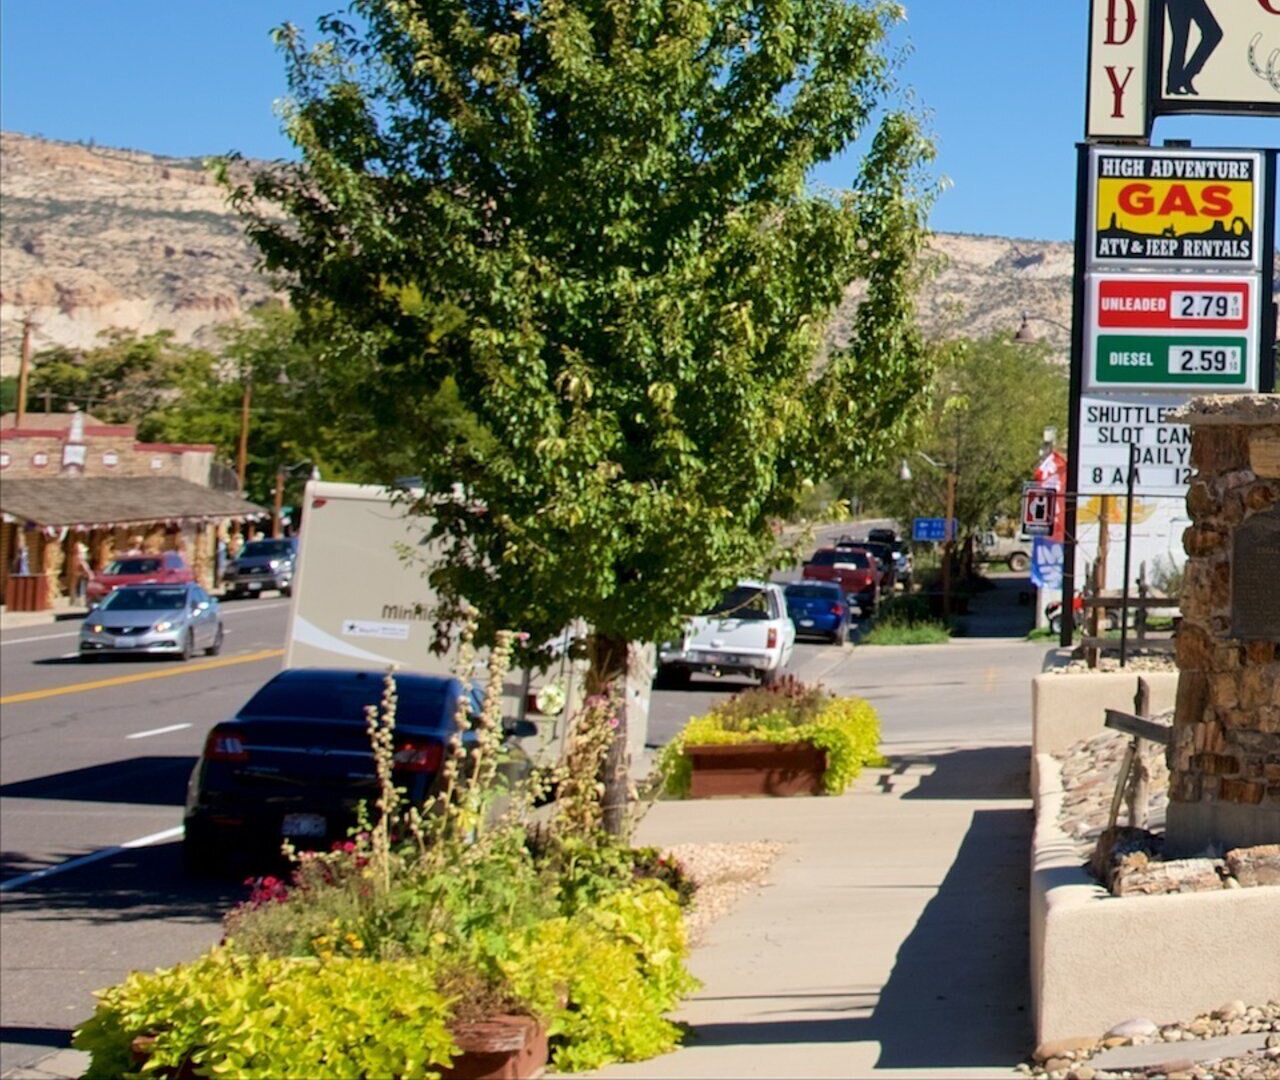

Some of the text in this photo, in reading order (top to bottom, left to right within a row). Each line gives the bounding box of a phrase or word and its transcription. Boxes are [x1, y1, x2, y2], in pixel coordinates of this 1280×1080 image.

[1102, 158, 1249, 179] HIGH ADVENTURE
[1118, 183, 1233, 217] GAS
[1099, 238, 1250, 258] ATV & JEEP RENTALS
[1101, 295, 1228, 317] UNLEADED 2.79
[1109, 349, 1226, 372] DIESEL 2.59
[1098, 427, 1143, 444] SLOT
[1133, 448, 1187, 465] DAILY
[1092, 467, 1103, 485] 8
